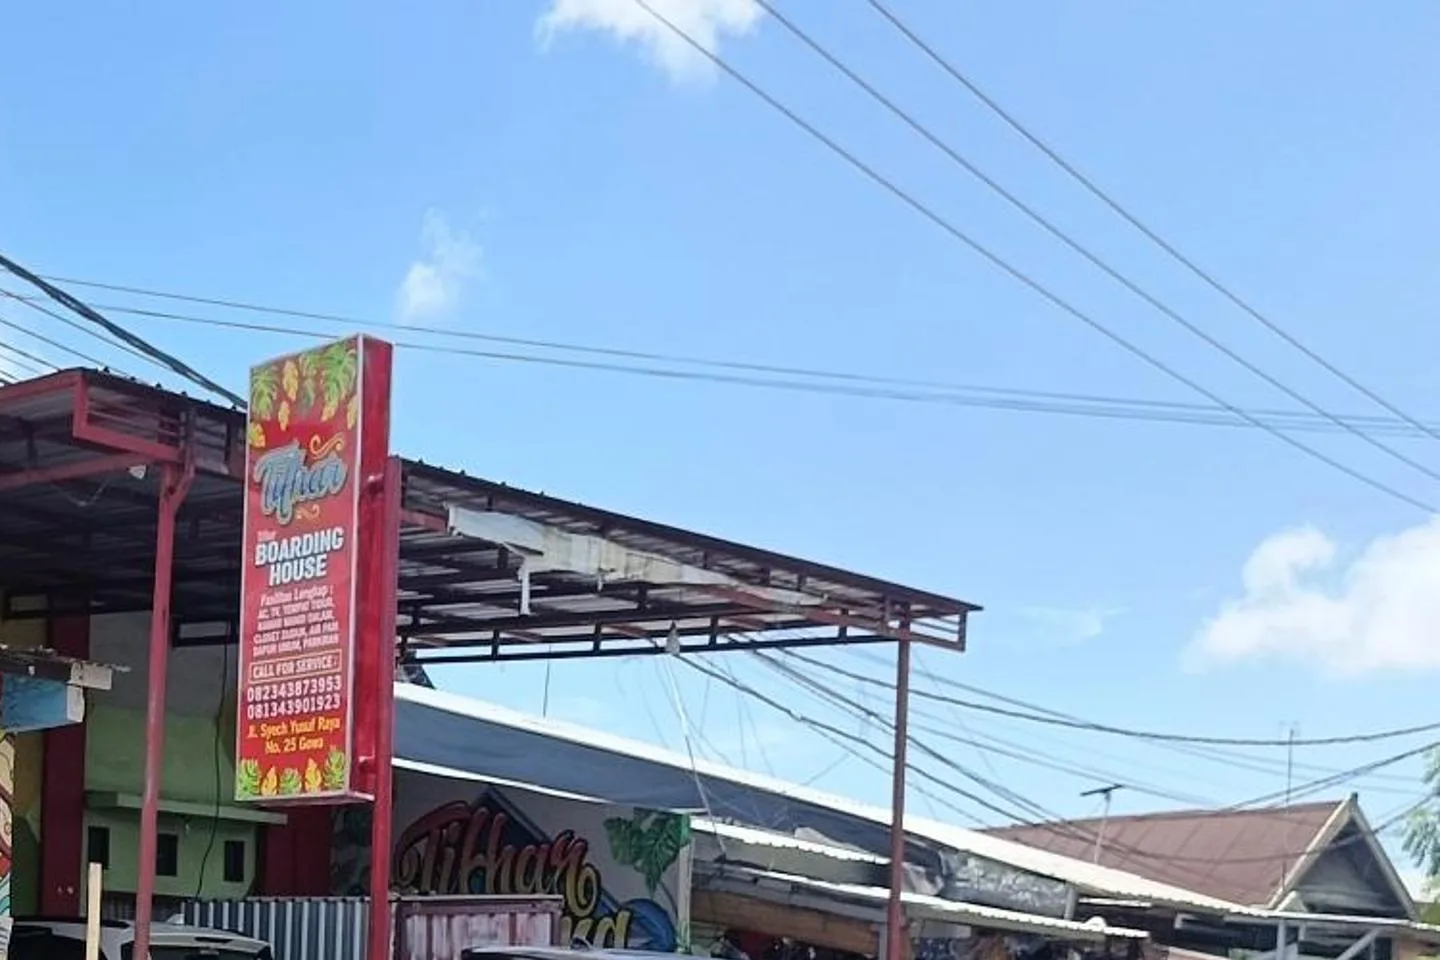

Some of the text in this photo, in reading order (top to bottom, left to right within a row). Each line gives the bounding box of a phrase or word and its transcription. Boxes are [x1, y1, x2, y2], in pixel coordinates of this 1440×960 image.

[255, 527, 344, 566] BOARDING
[269, 554, 327, 586] HOUSE
[253, 663, 275, 679] CALL
[275, 660, 295, 676] FOR
[296, 655, 332, 673] SERVICE
[247, 675, 341, 702] 082343873953
[247, 692, 340, 719] 081343901923
[317, 715, 341, 733] Raya
[282, 736, 297, 752] 25
